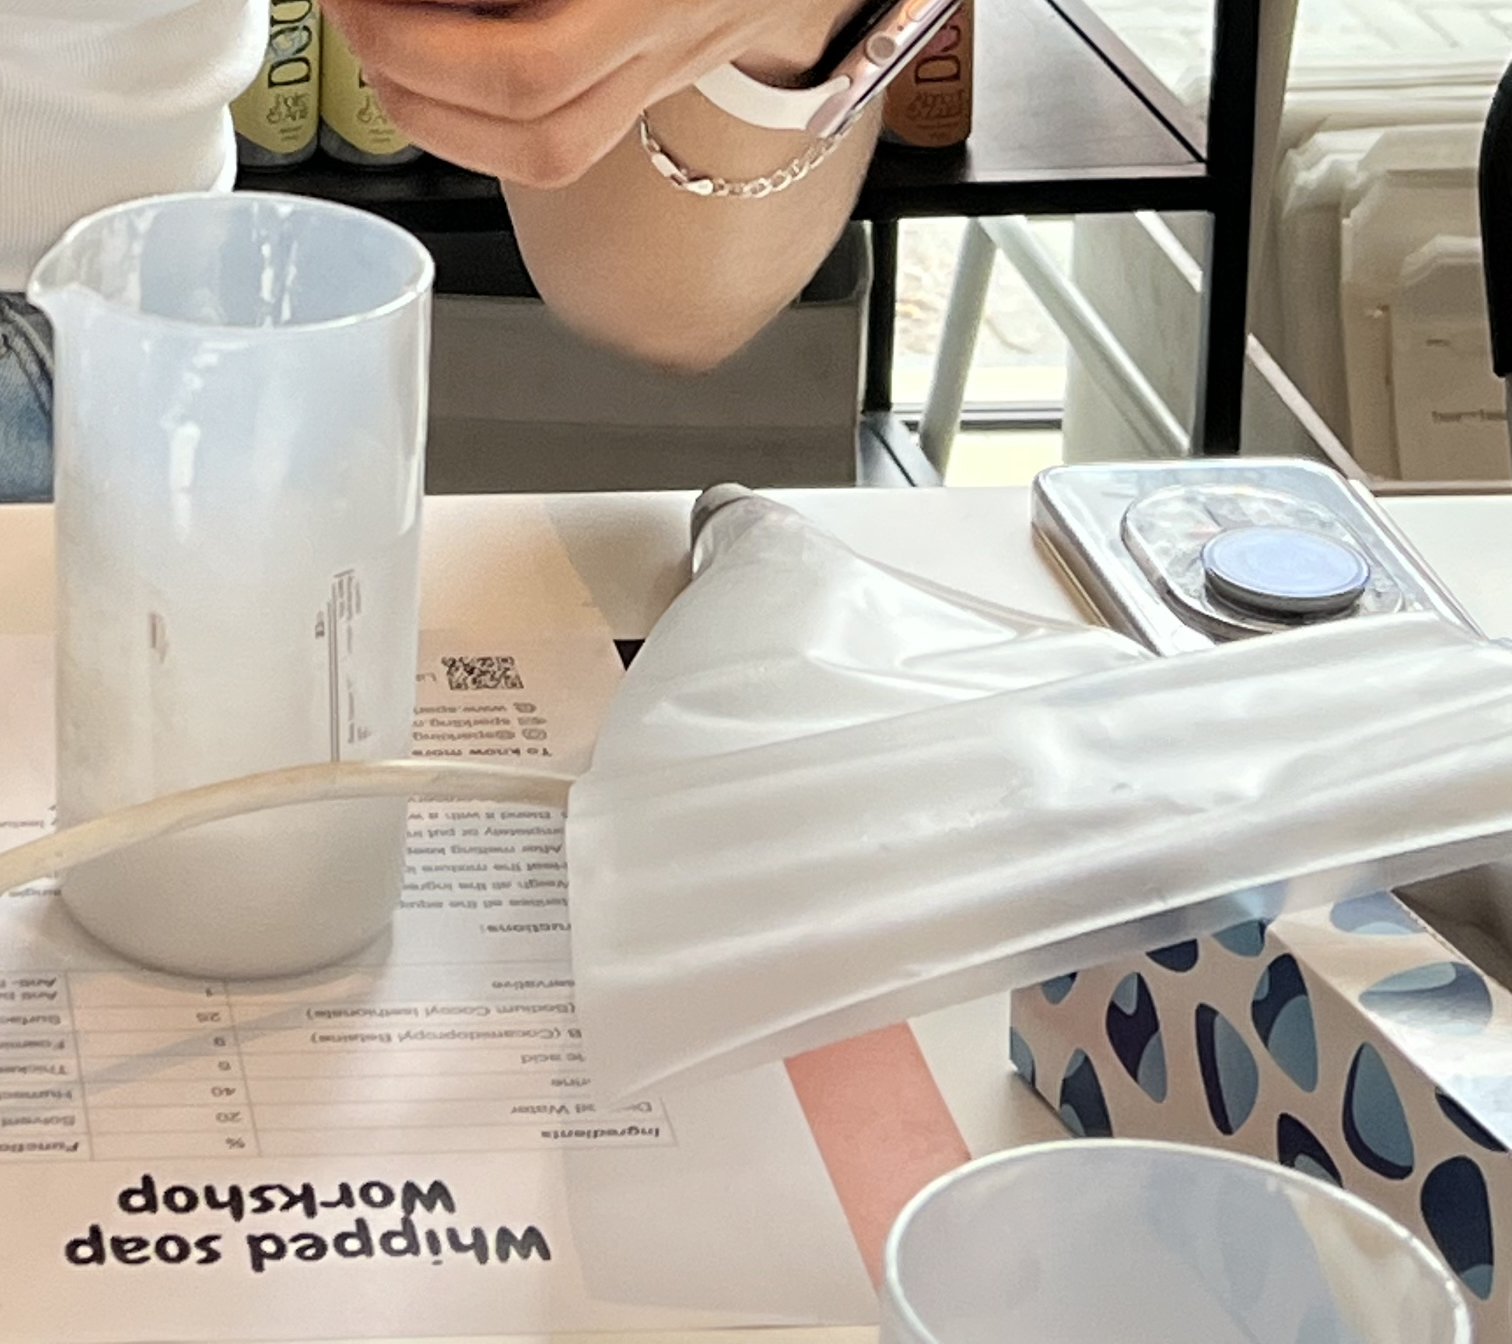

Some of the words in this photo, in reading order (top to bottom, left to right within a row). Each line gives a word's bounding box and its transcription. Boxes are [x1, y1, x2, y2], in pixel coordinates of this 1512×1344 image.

[216, 1110, 242, 1123] 20
[540, 1125, 662, 1142] Ingredients
[118, 1174, 454, 1220] Workshop
[65, 1226, 222, 1271] soap
[249, 1218, 551, 1273] Whipped
